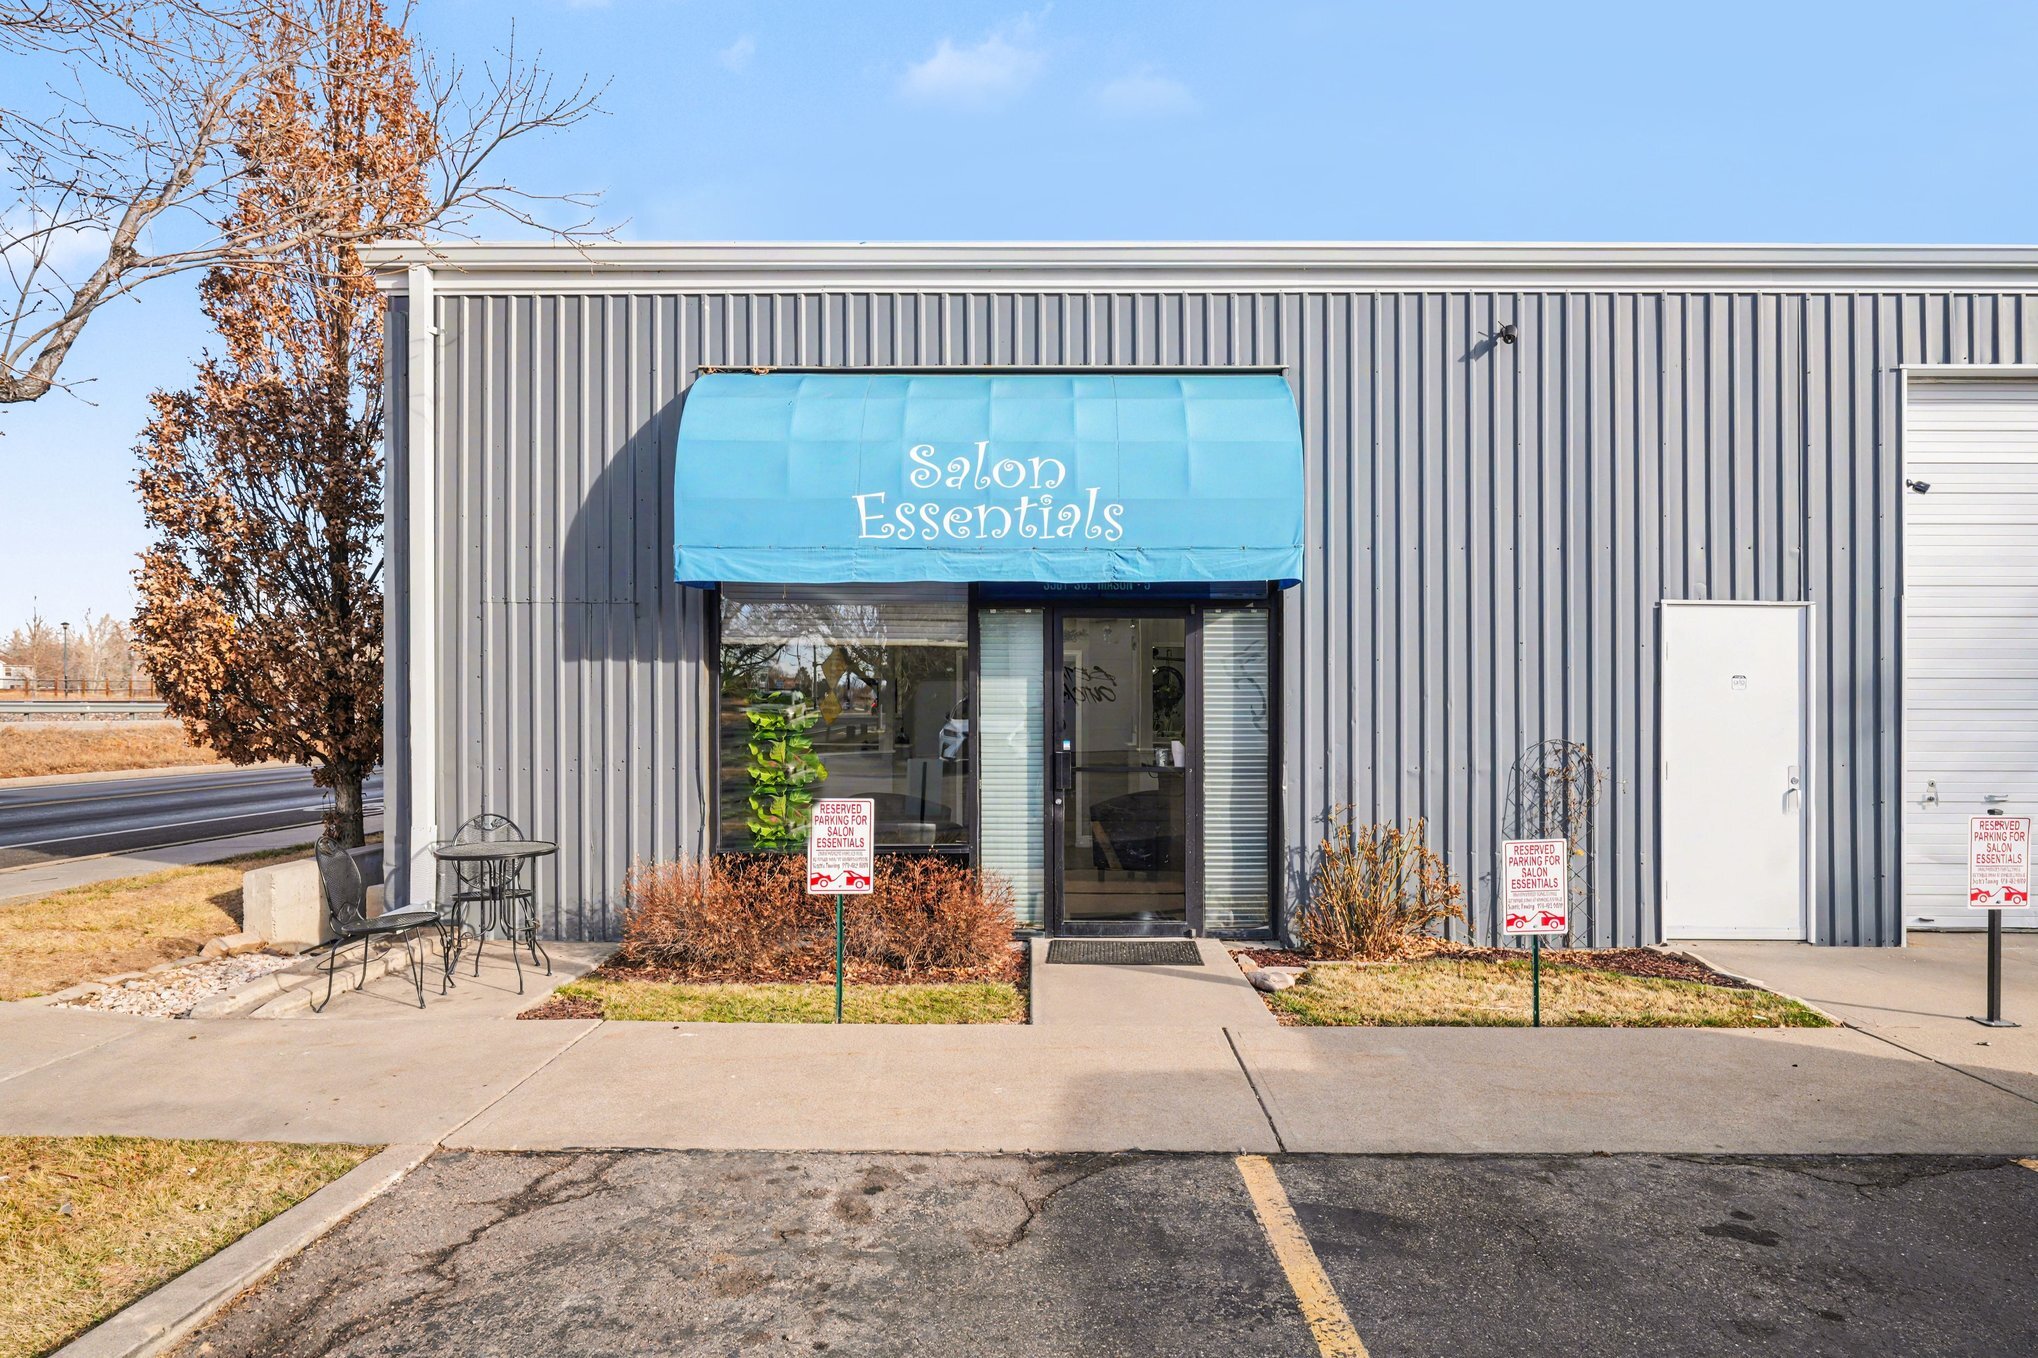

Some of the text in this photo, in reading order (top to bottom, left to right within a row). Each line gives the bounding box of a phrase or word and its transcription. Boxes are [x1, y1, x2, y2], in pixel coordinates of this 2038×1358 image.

[909, 440, 1066, 490] Salon
[851, 486, 1124, 542] Essentials
[820, 803, 862, 814] RESERVED
[814, 815, 867, 826] PARKING FOR
[1979, 820, 2020, 831] RESERVED
[827, 826, 854, 837] SALON
[1974, 831, 2025, 842] PARKING FOR
[816, 837, 865, 848] ESSENTIALS
[1986, 842, 2012, 853] SALON
[1513, 844, 1555, 855] RESERVED
[1508, 855, 1560, 867] PARKING FOR
[1976, 853, 2022, 864] ESSENTIALS
[1521, 867, 1548, 878] SALON
[1511, 878, 1558, 890] ESSENTIALS
